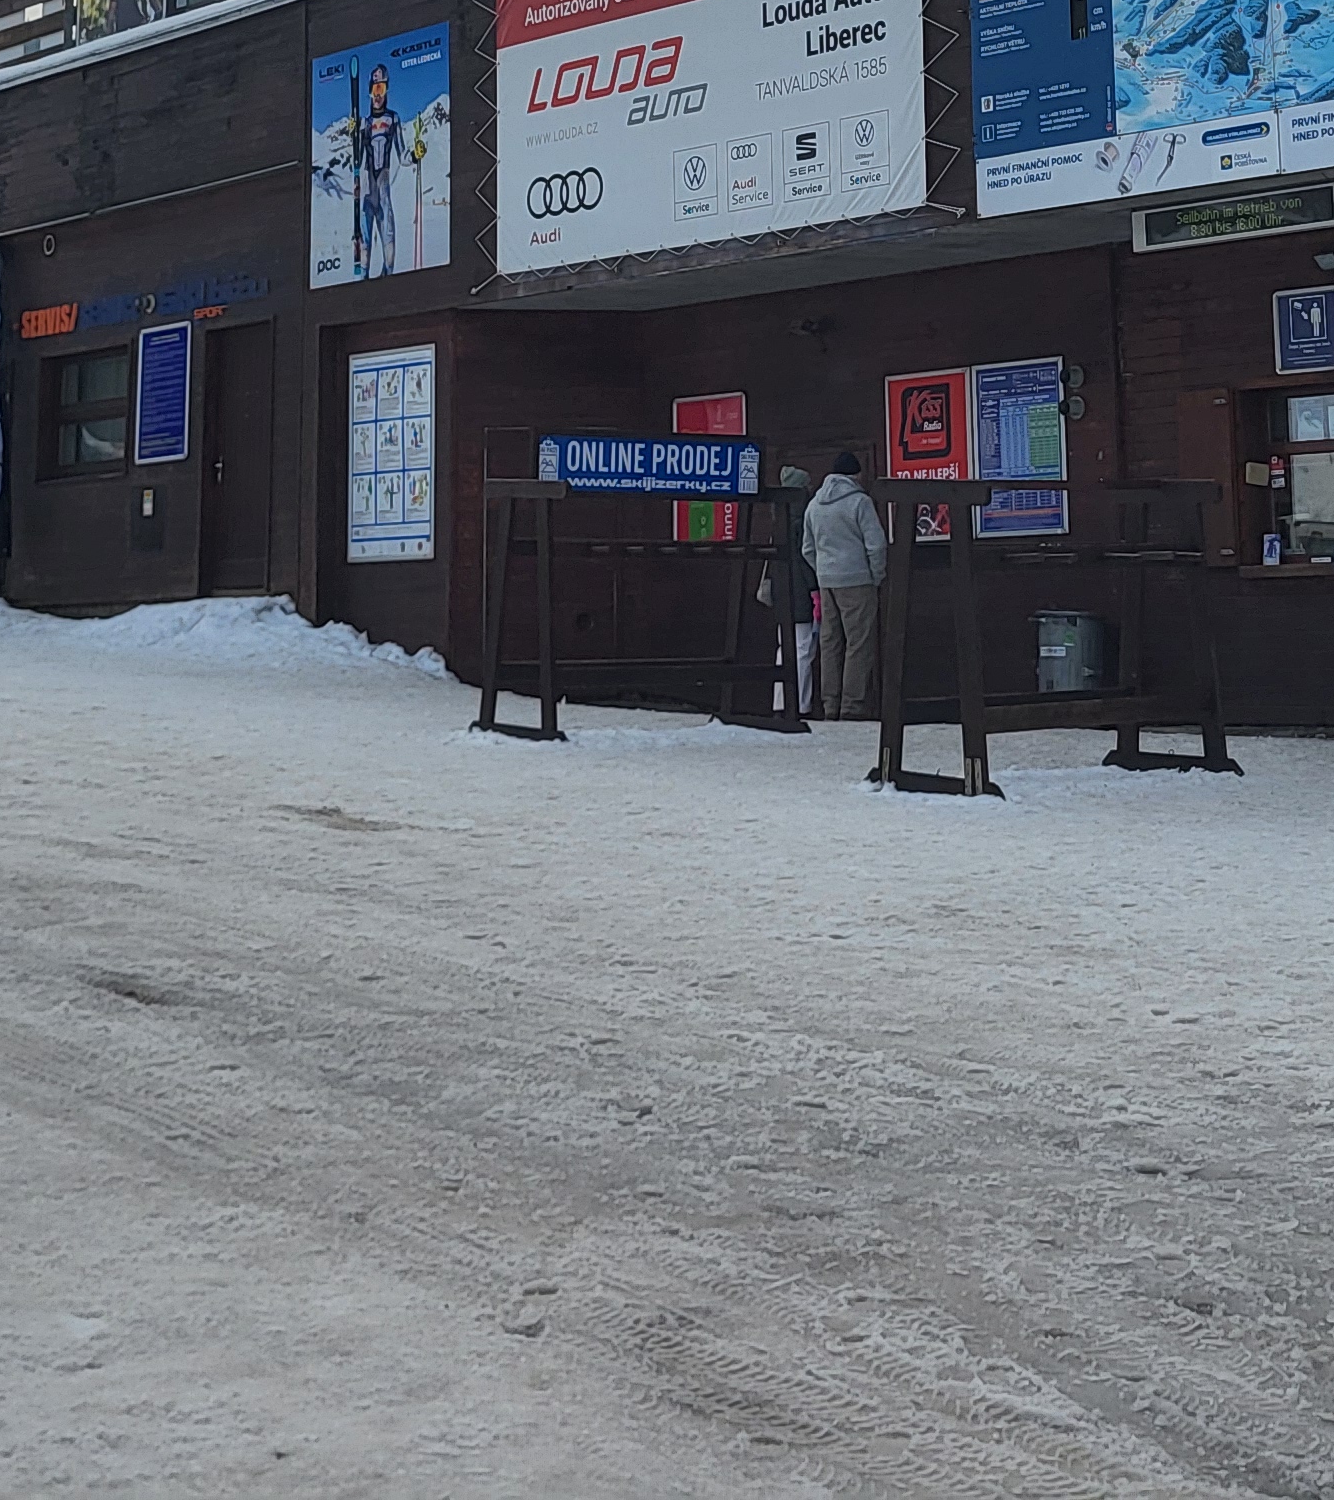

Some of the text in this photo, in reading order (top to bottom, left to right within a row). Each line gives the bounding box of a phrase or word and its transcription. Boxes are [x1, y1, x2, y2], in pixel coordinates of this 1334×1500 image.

[805, 19, 887, 57] Liberec
[318, 63, 345, 79] LEKI
[755, 56, 888, 101] TANVALDSKÁ 1585
[1291, 112, 1322, 129] PRVNÍ
[526, 122, 599, 148] WWW.LOUDA.CZ
[1291, 127, 1320, 143] HNED
[1320, 126, 1334, 138] PO
[788, 163, 825, 177] SEAT
[986, 152, 1083, 178] PRVNÍ FINANČNÍ POMOC
[732, 176, 757, 191] Audi
[849, 172, 882, 186] Service
[986, 169, 1052, 191] HNED PO ÚRAZU
[731, 189, 769, 205] Service
[791, 183, 823, 197] Service
[682, 203, 710, 215] Service
[1176, 197, 1302, 225] Seilbahn im Betrieb von
[1216, 221, 1232, 233] bis
[529, 227, 562, 246] Audi
[923, 421, 942, 431] Radio
[567, 440, 733, 477] ONLINE PRODEJ
[567, 476, 732, 493] www.skijizerky.cz
[723, 502, 733, 540] inno
